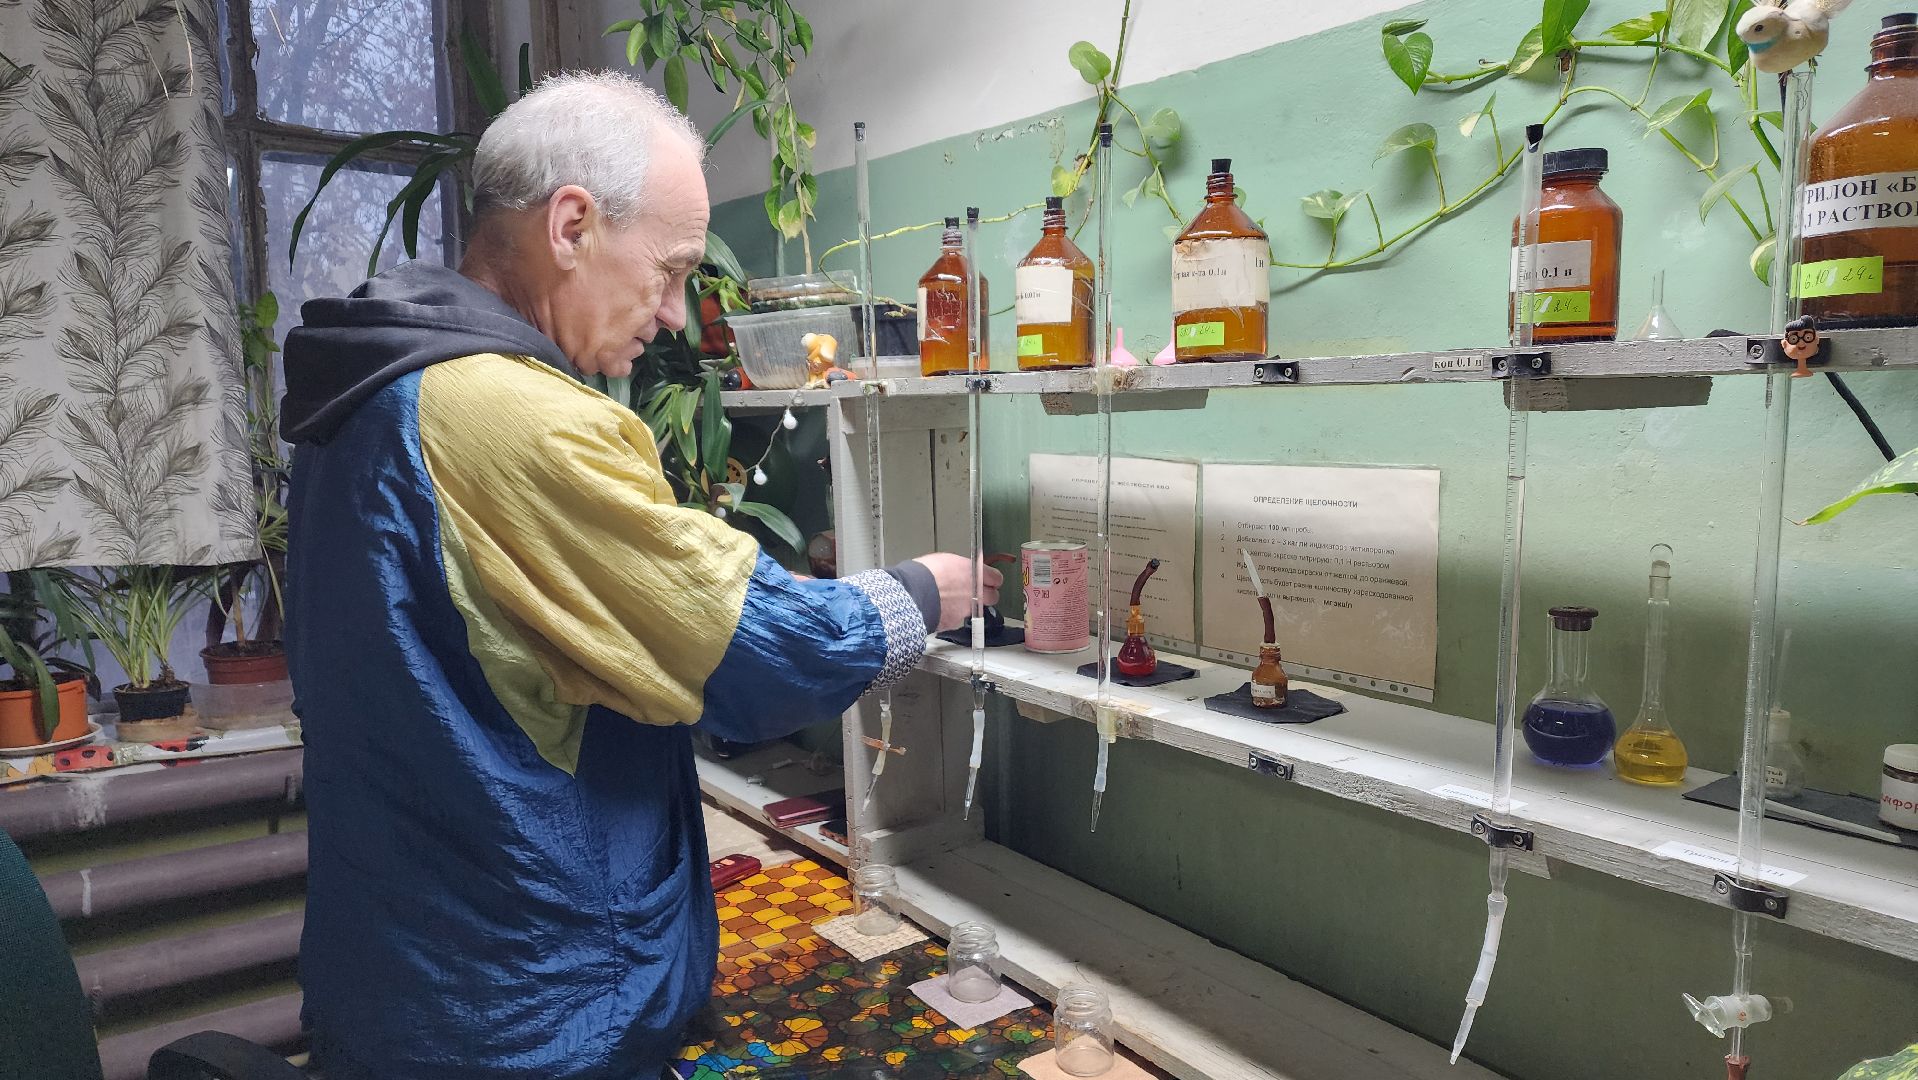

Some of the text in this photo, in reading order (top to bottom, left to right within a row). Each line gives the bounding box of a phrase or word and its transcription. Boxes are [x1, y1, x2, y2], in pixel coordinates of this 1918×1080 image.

[1541, 267, 1558, 279] 0.1
[1253, 495, 1358, 508] ОПРЕДЕЛЕНИЕ ЩЕЛОЧНОСТИ
